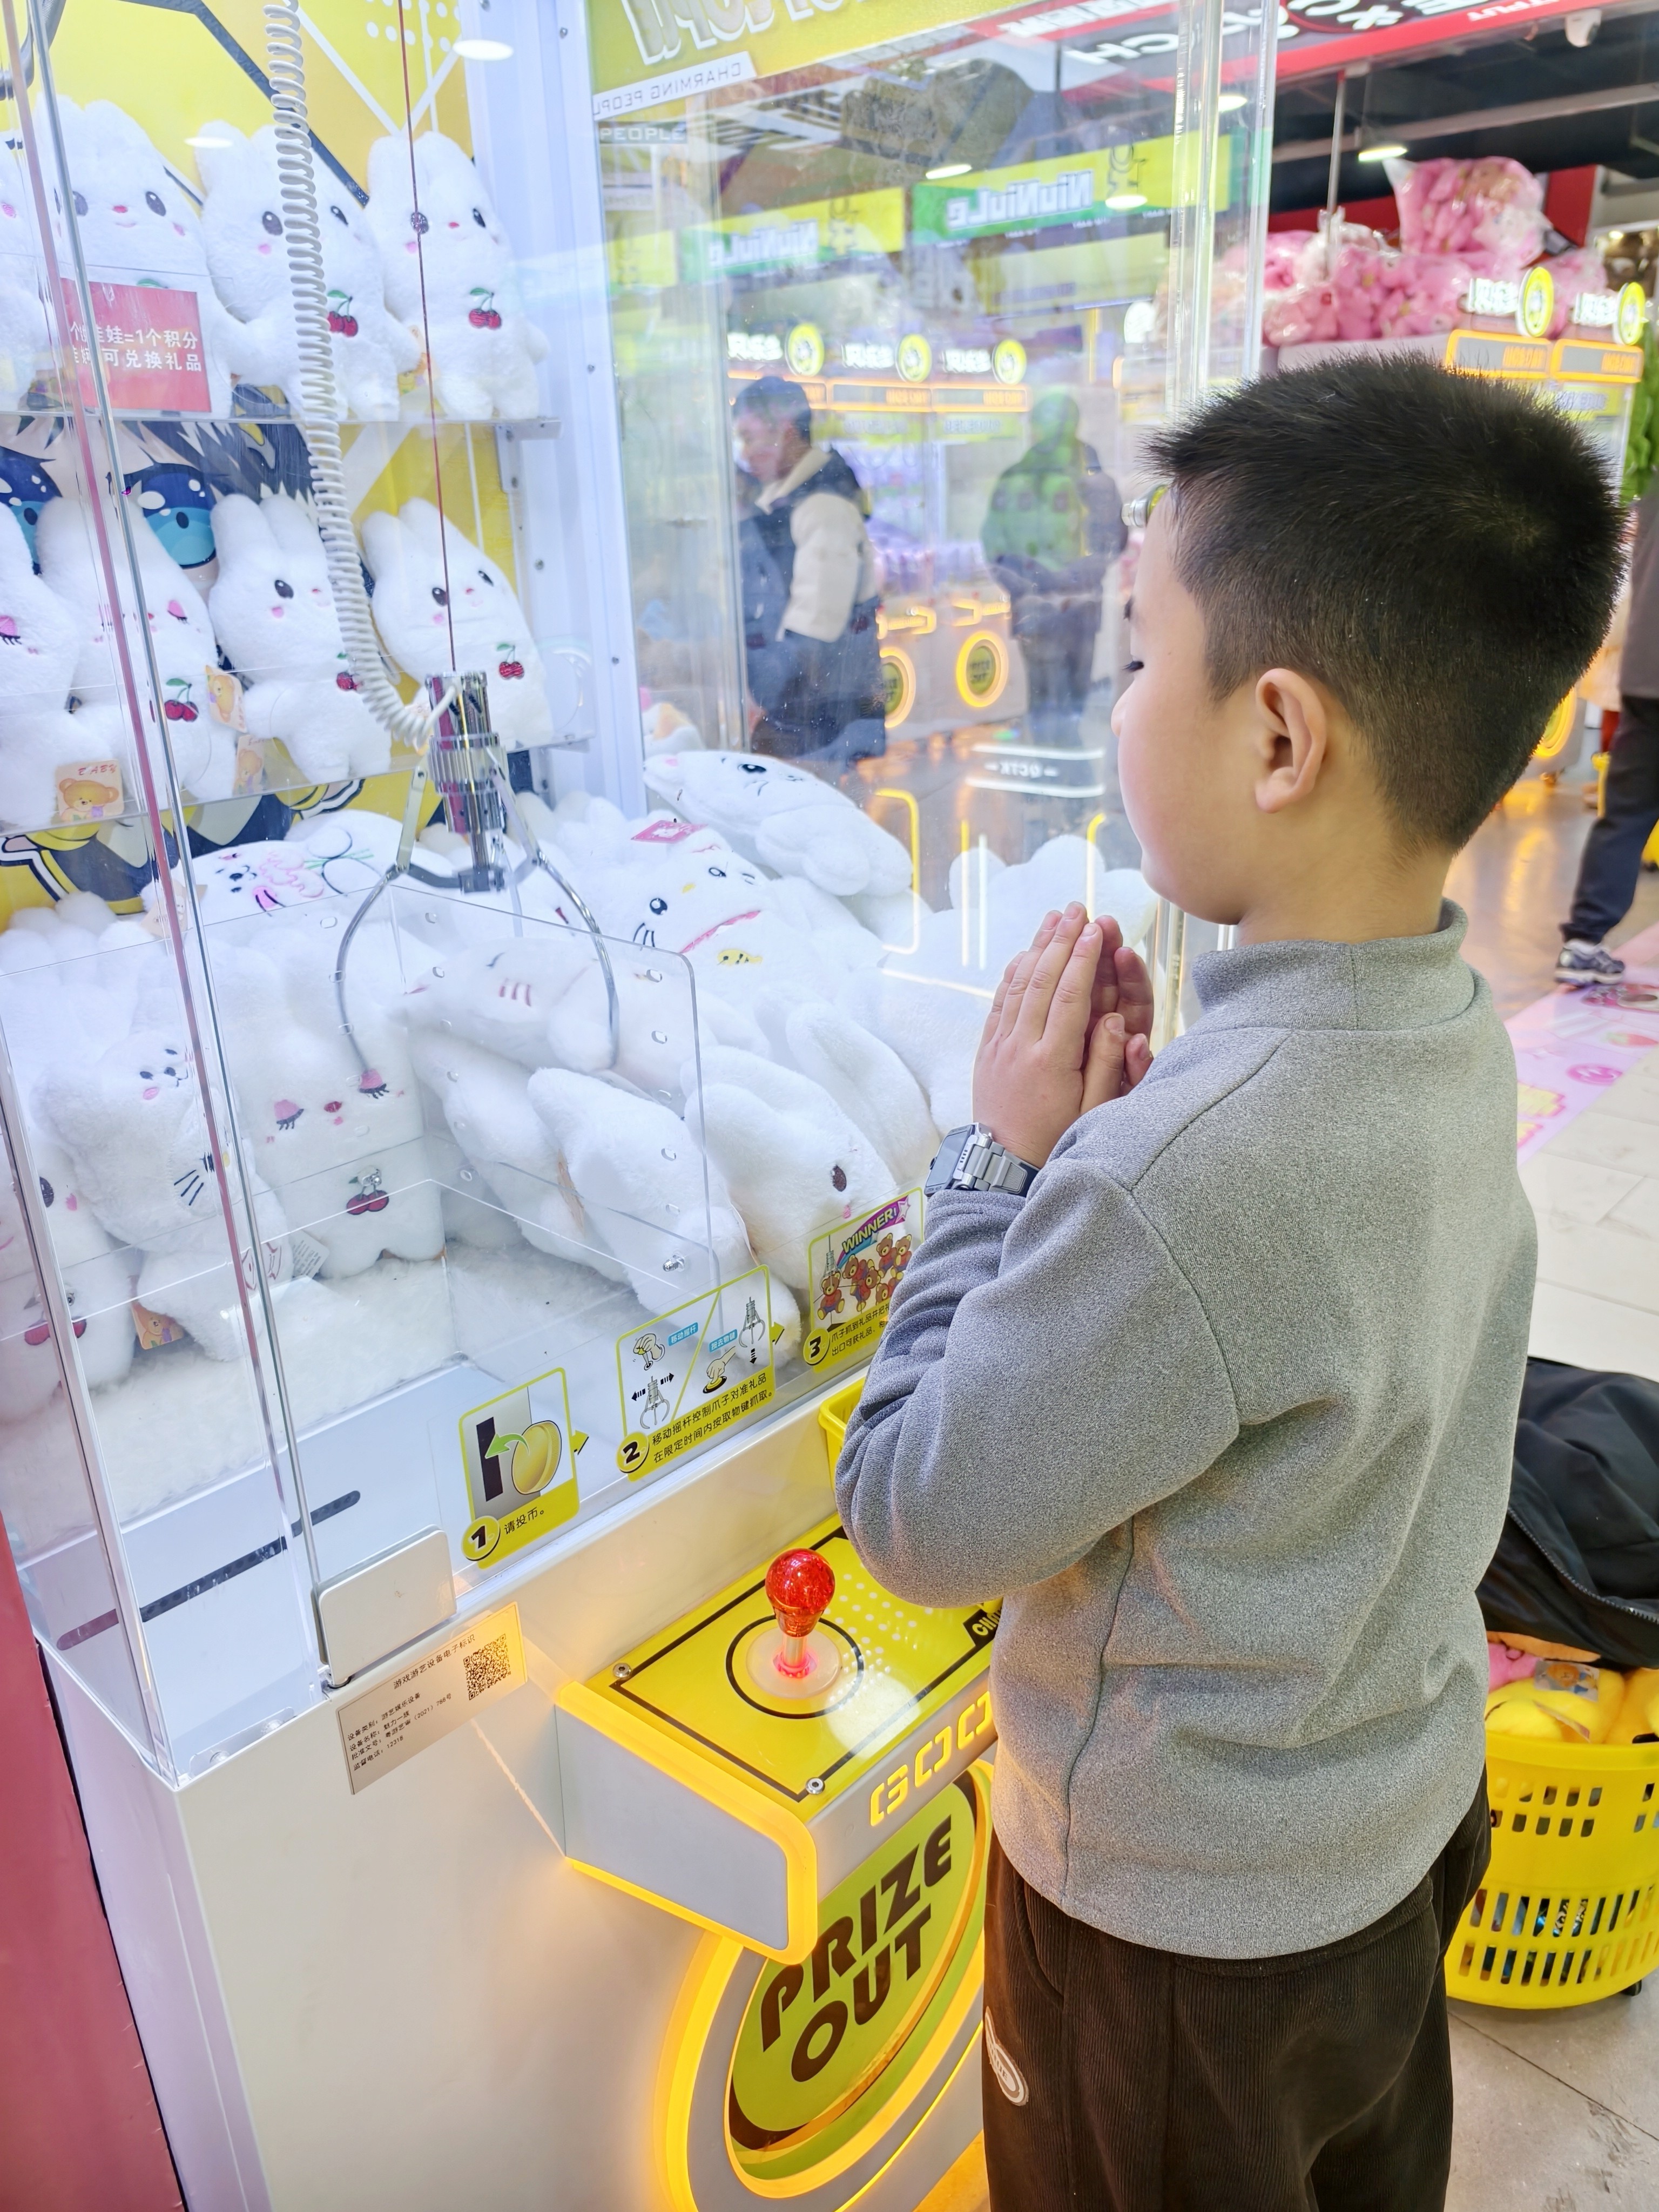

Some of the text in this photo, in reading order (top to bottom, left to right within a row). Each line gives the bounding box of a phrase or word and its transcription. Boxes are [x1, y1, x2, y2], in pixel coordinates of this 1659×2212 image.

[600, 127, 686, 140] PEOPLE
[810, 1335, 821, 1359] 3
[652, 1372, 767, 1446] 移动摇杆控制爪子对准礼品
[622, 1441, 640, 1464] 2
[471, 1525, 486, 1549] 1
[393, 1634, 475, 1689] 游戏游艺设备电子标识
[760, 1813, 952, 2053] PRIZE
[791, 1903, 932, 2083] OUT
